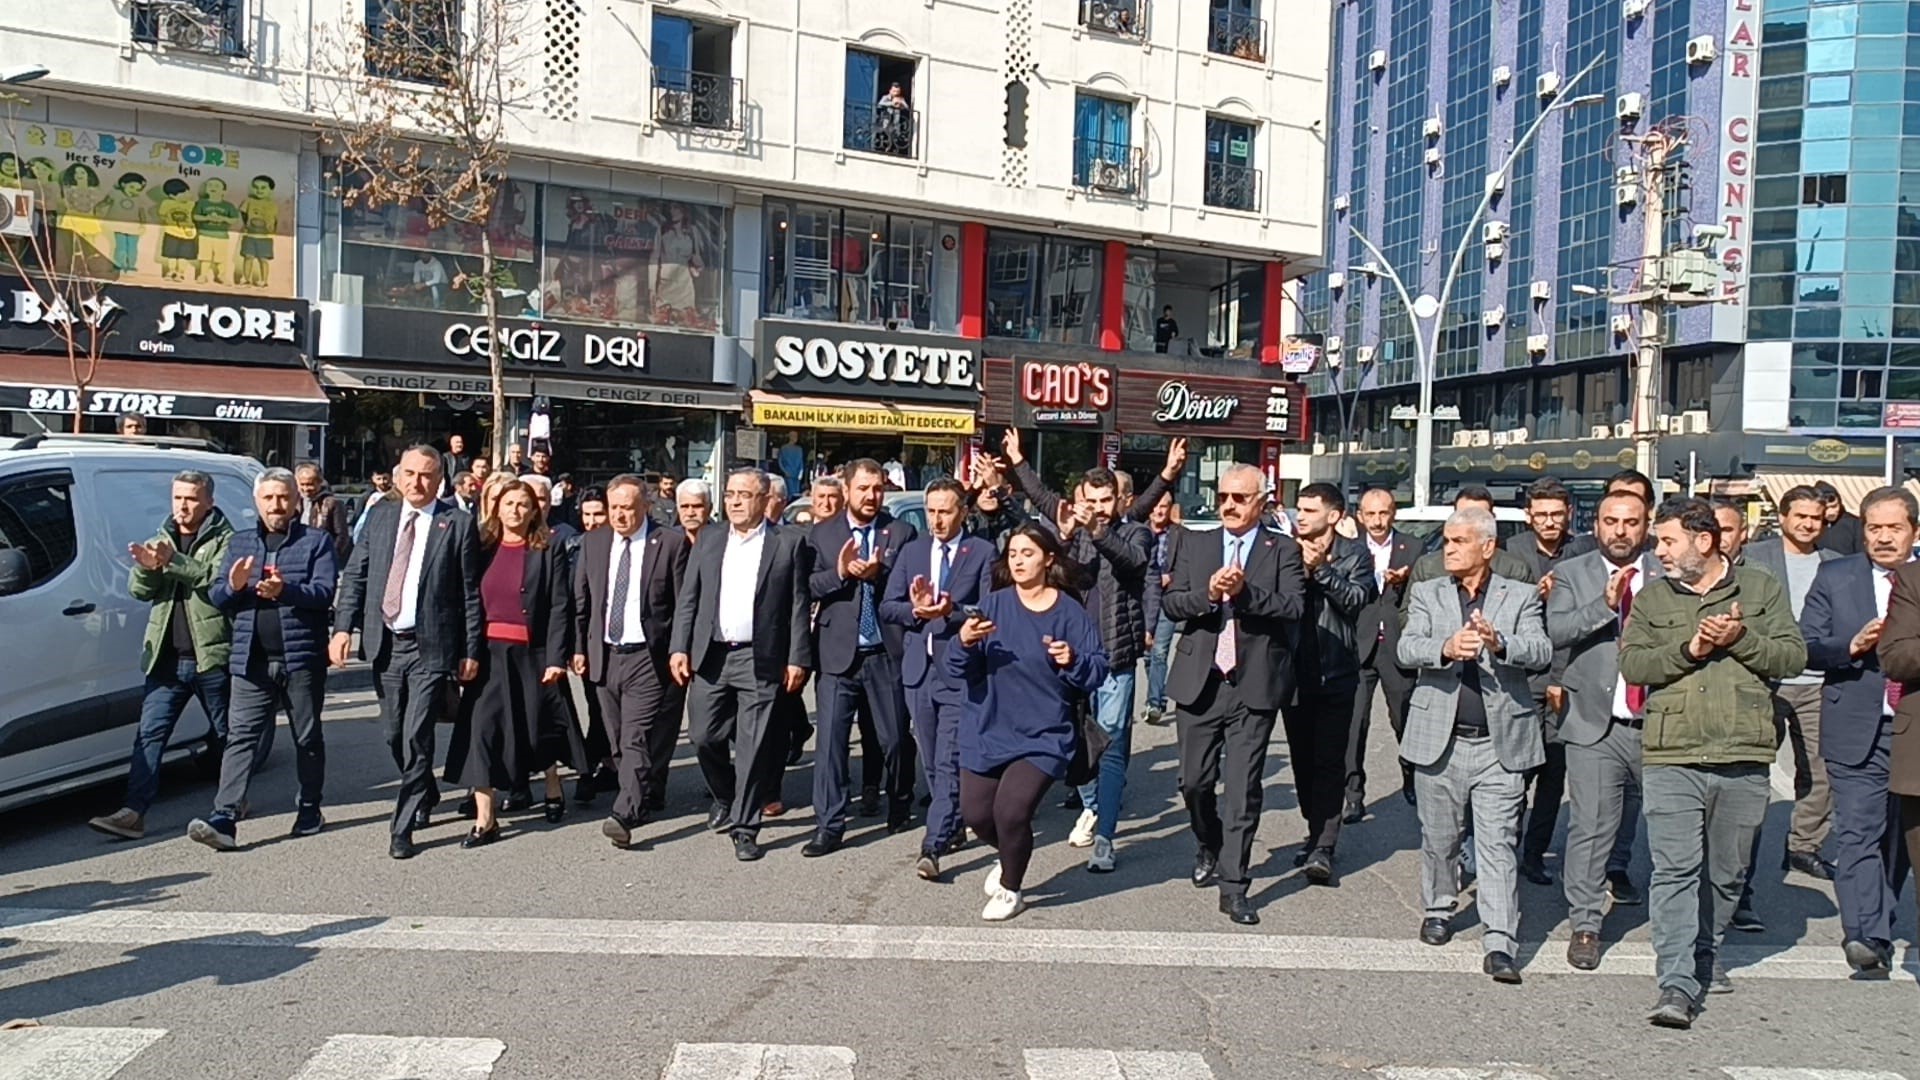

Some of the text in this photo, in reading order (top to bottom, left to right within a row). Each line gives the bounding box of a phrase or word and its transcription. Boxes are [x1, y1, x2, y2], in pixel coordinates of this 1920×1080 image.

[54, 127, 241, 169] BABY STORE
[65, 152, 89, 163] Her
[9, 289, 296, 342] BAY STORE
[139, 340, 175, 353] Giyim
[774, 335, 974, 387] SOSYETE
[362, 375, 437, 390] CENGİZ
[1022, 360, 1111, 406] CAO'S
[28, 389, 176, 415] BAY STORE
[586, 387, 700, 405] CENGİZ DERİ
[1155, 380, 1239, 422] Döner
[215, 400, 264, 420] GİYİM
[763, 409, 956, 429] BAKALIM İLK KİM BİZİ TAKLİT EDECEK
